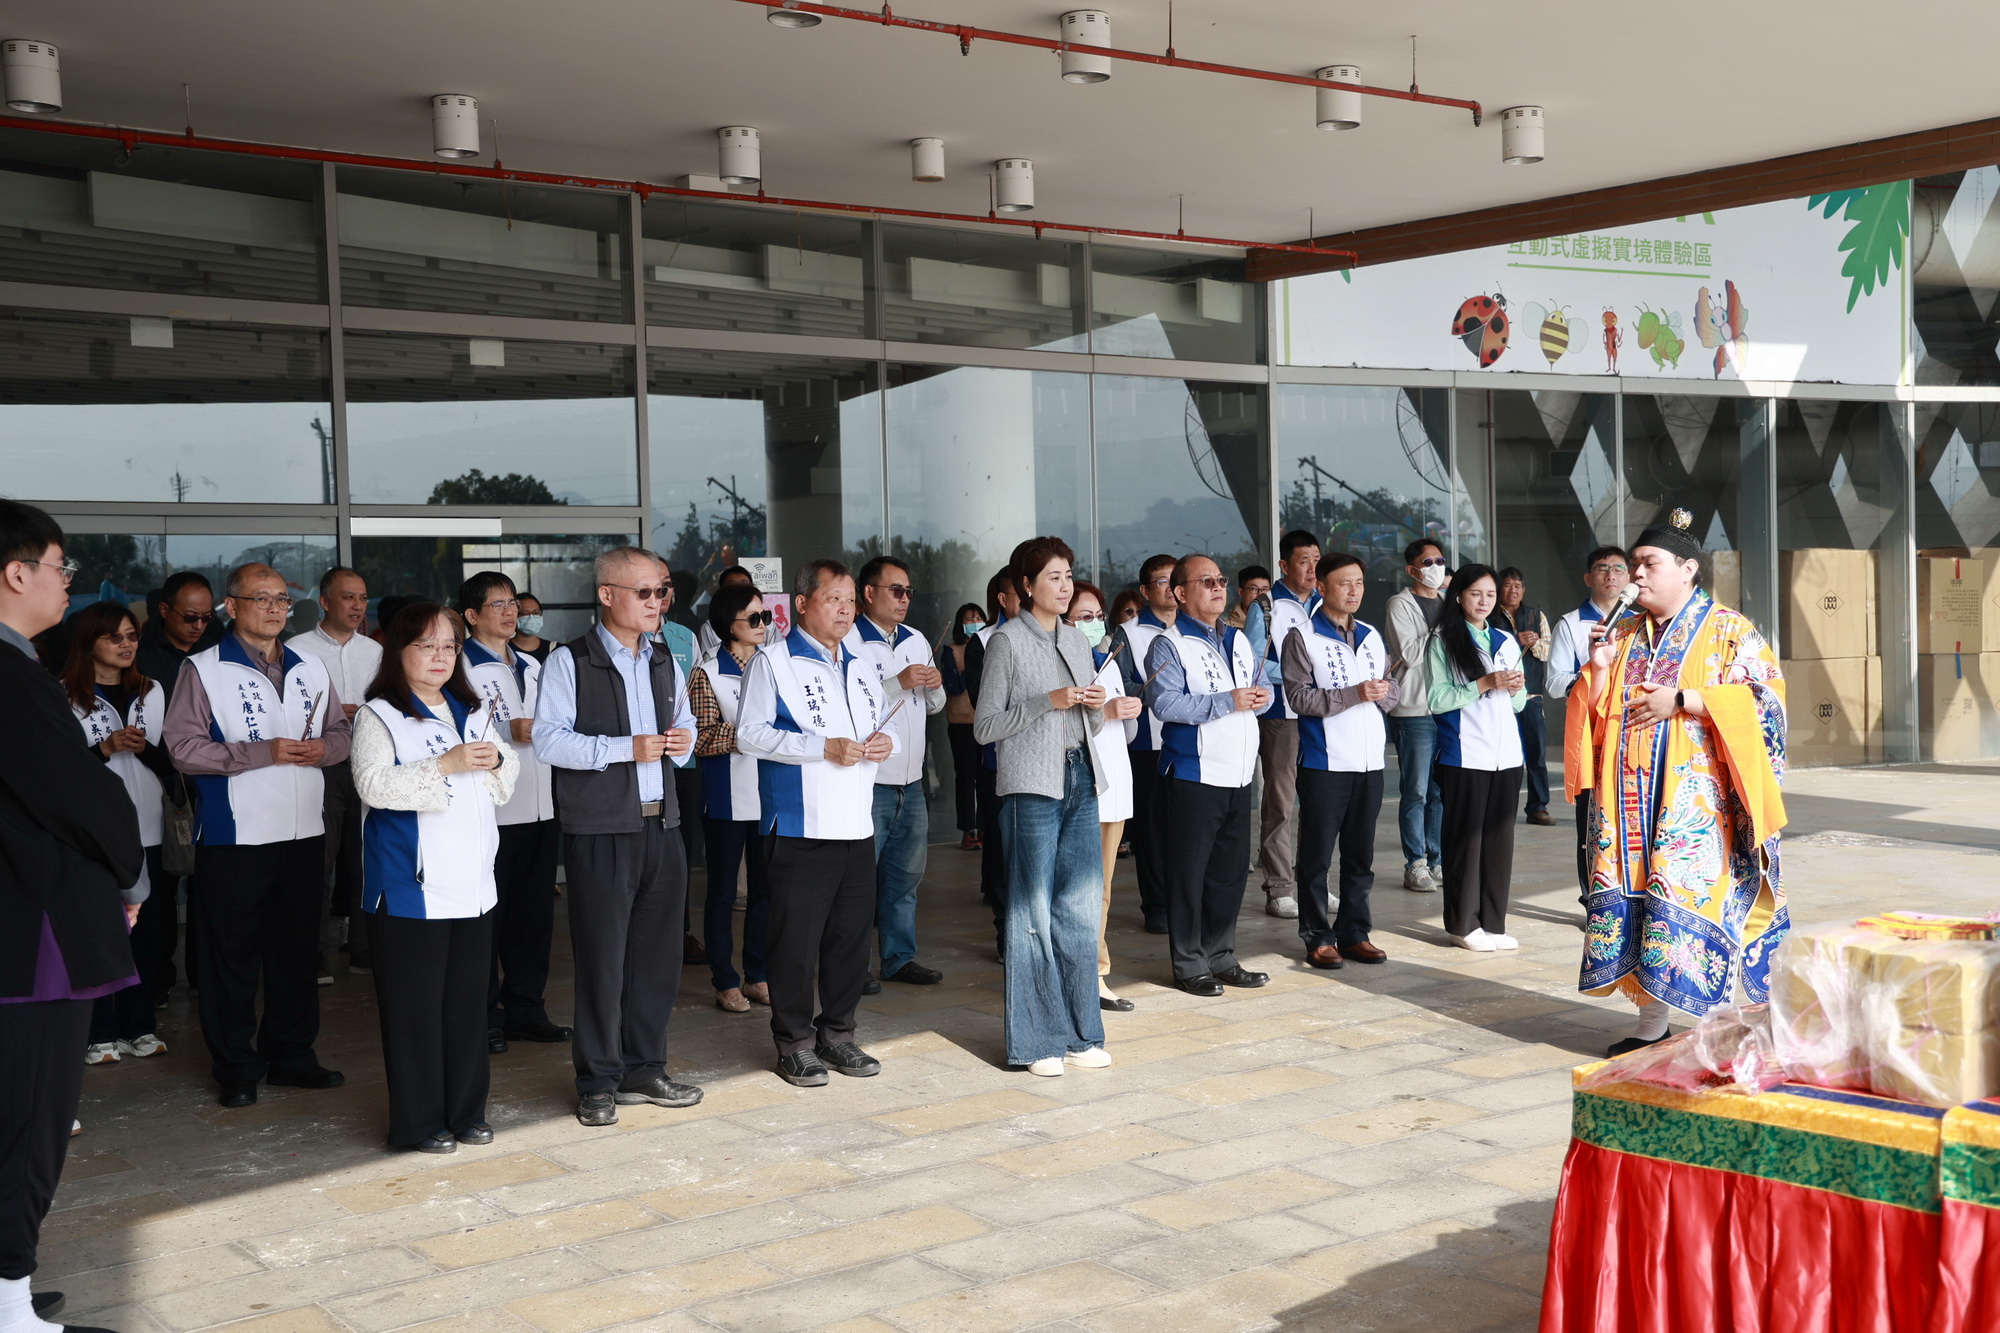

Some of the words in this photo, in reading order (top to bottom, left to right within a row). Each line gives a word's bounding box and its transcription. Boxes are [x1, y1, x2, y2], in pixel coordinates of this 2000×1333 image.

[248, 680, 267, 714] 地政處
[803, 684, 826, 728] 王瑞德
